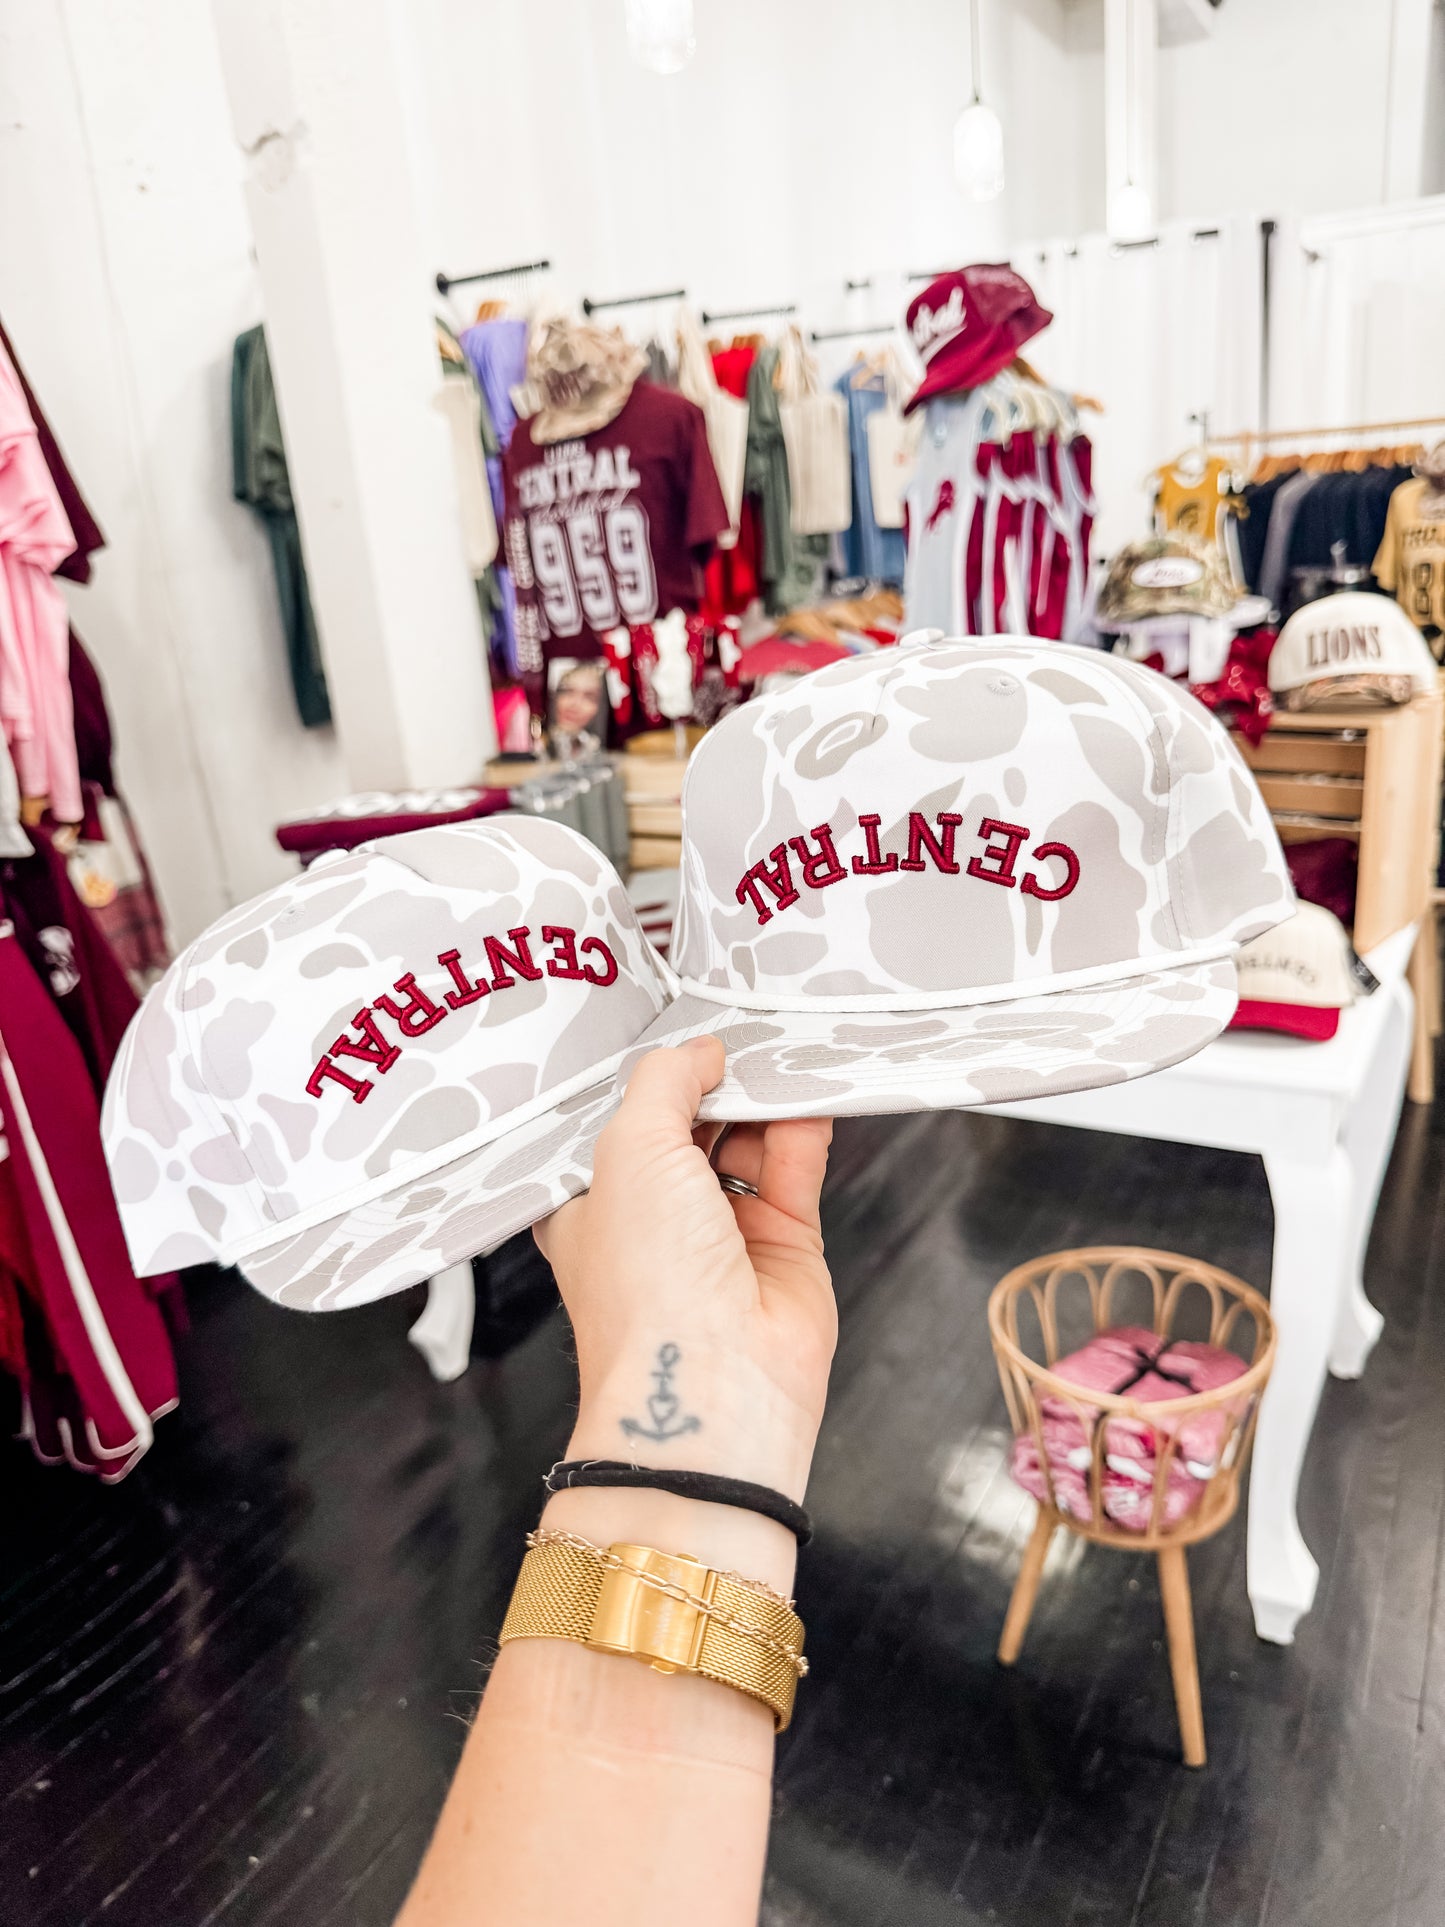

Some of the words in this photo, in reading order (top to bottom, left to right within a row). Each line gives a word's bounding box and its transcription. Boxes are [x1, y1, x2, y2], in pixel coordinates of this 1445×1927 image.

[1306, 625, 1382, 667] LIONS
[736, 812, 1081, 925] CENTRAL
[305, 925, 618, 1104] CENTRAL
